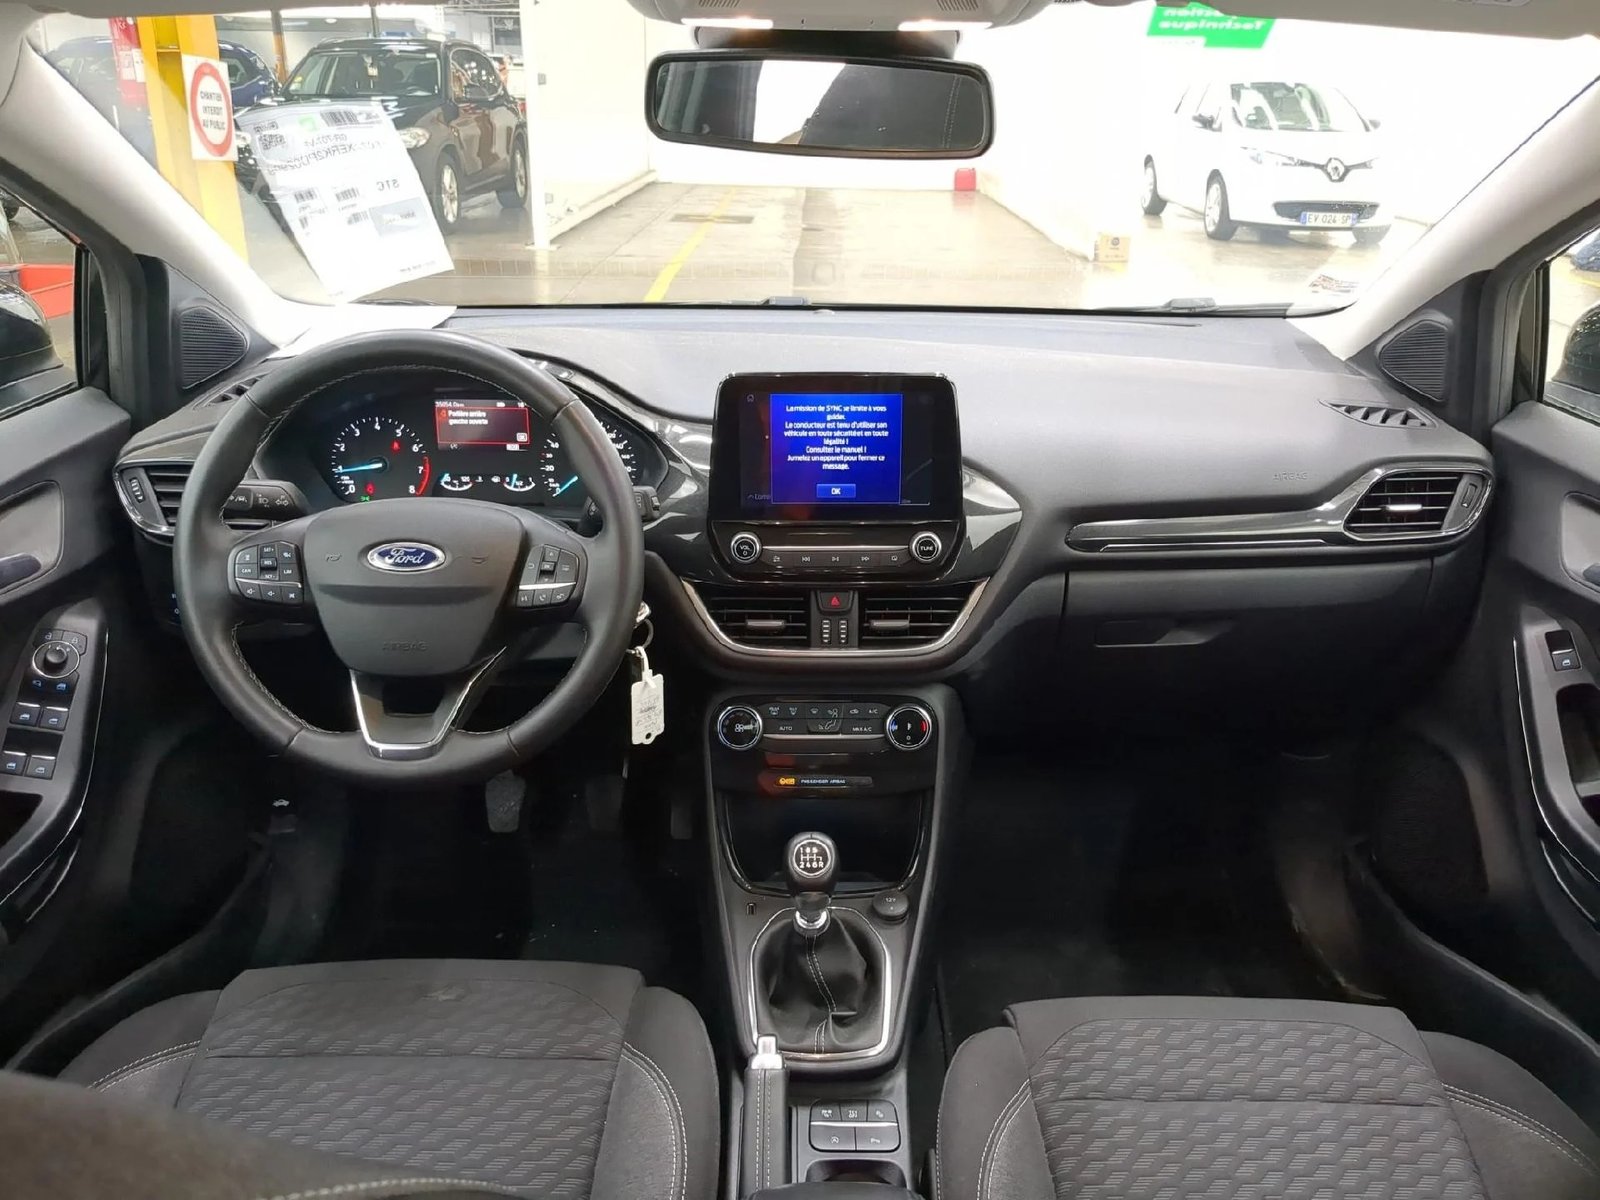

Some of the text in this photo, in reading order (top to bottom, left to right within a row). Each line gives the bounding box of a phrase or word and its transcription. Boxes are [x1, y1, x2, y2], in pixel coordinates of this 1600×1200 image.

[202, 105, 223, 116] INTERDIT
[209, 120, 225, 130] PUBLIC
[374, 422, 380, 430] 4
[354, 428, 360, 437] 3
[395, 429, 402, 437] 5
[340, 443, 346, 452] 2
[412, 444, 418, 452] 6
[417, 466, 423, 474] 7
[1273, 471, 1308, 480] AIRBAG
[349, 485, 355, 493] 0
[408, 485, 415, 494] 8
[831, 487, 841, 495] OK
[384, 547, 424, 565] Ford
